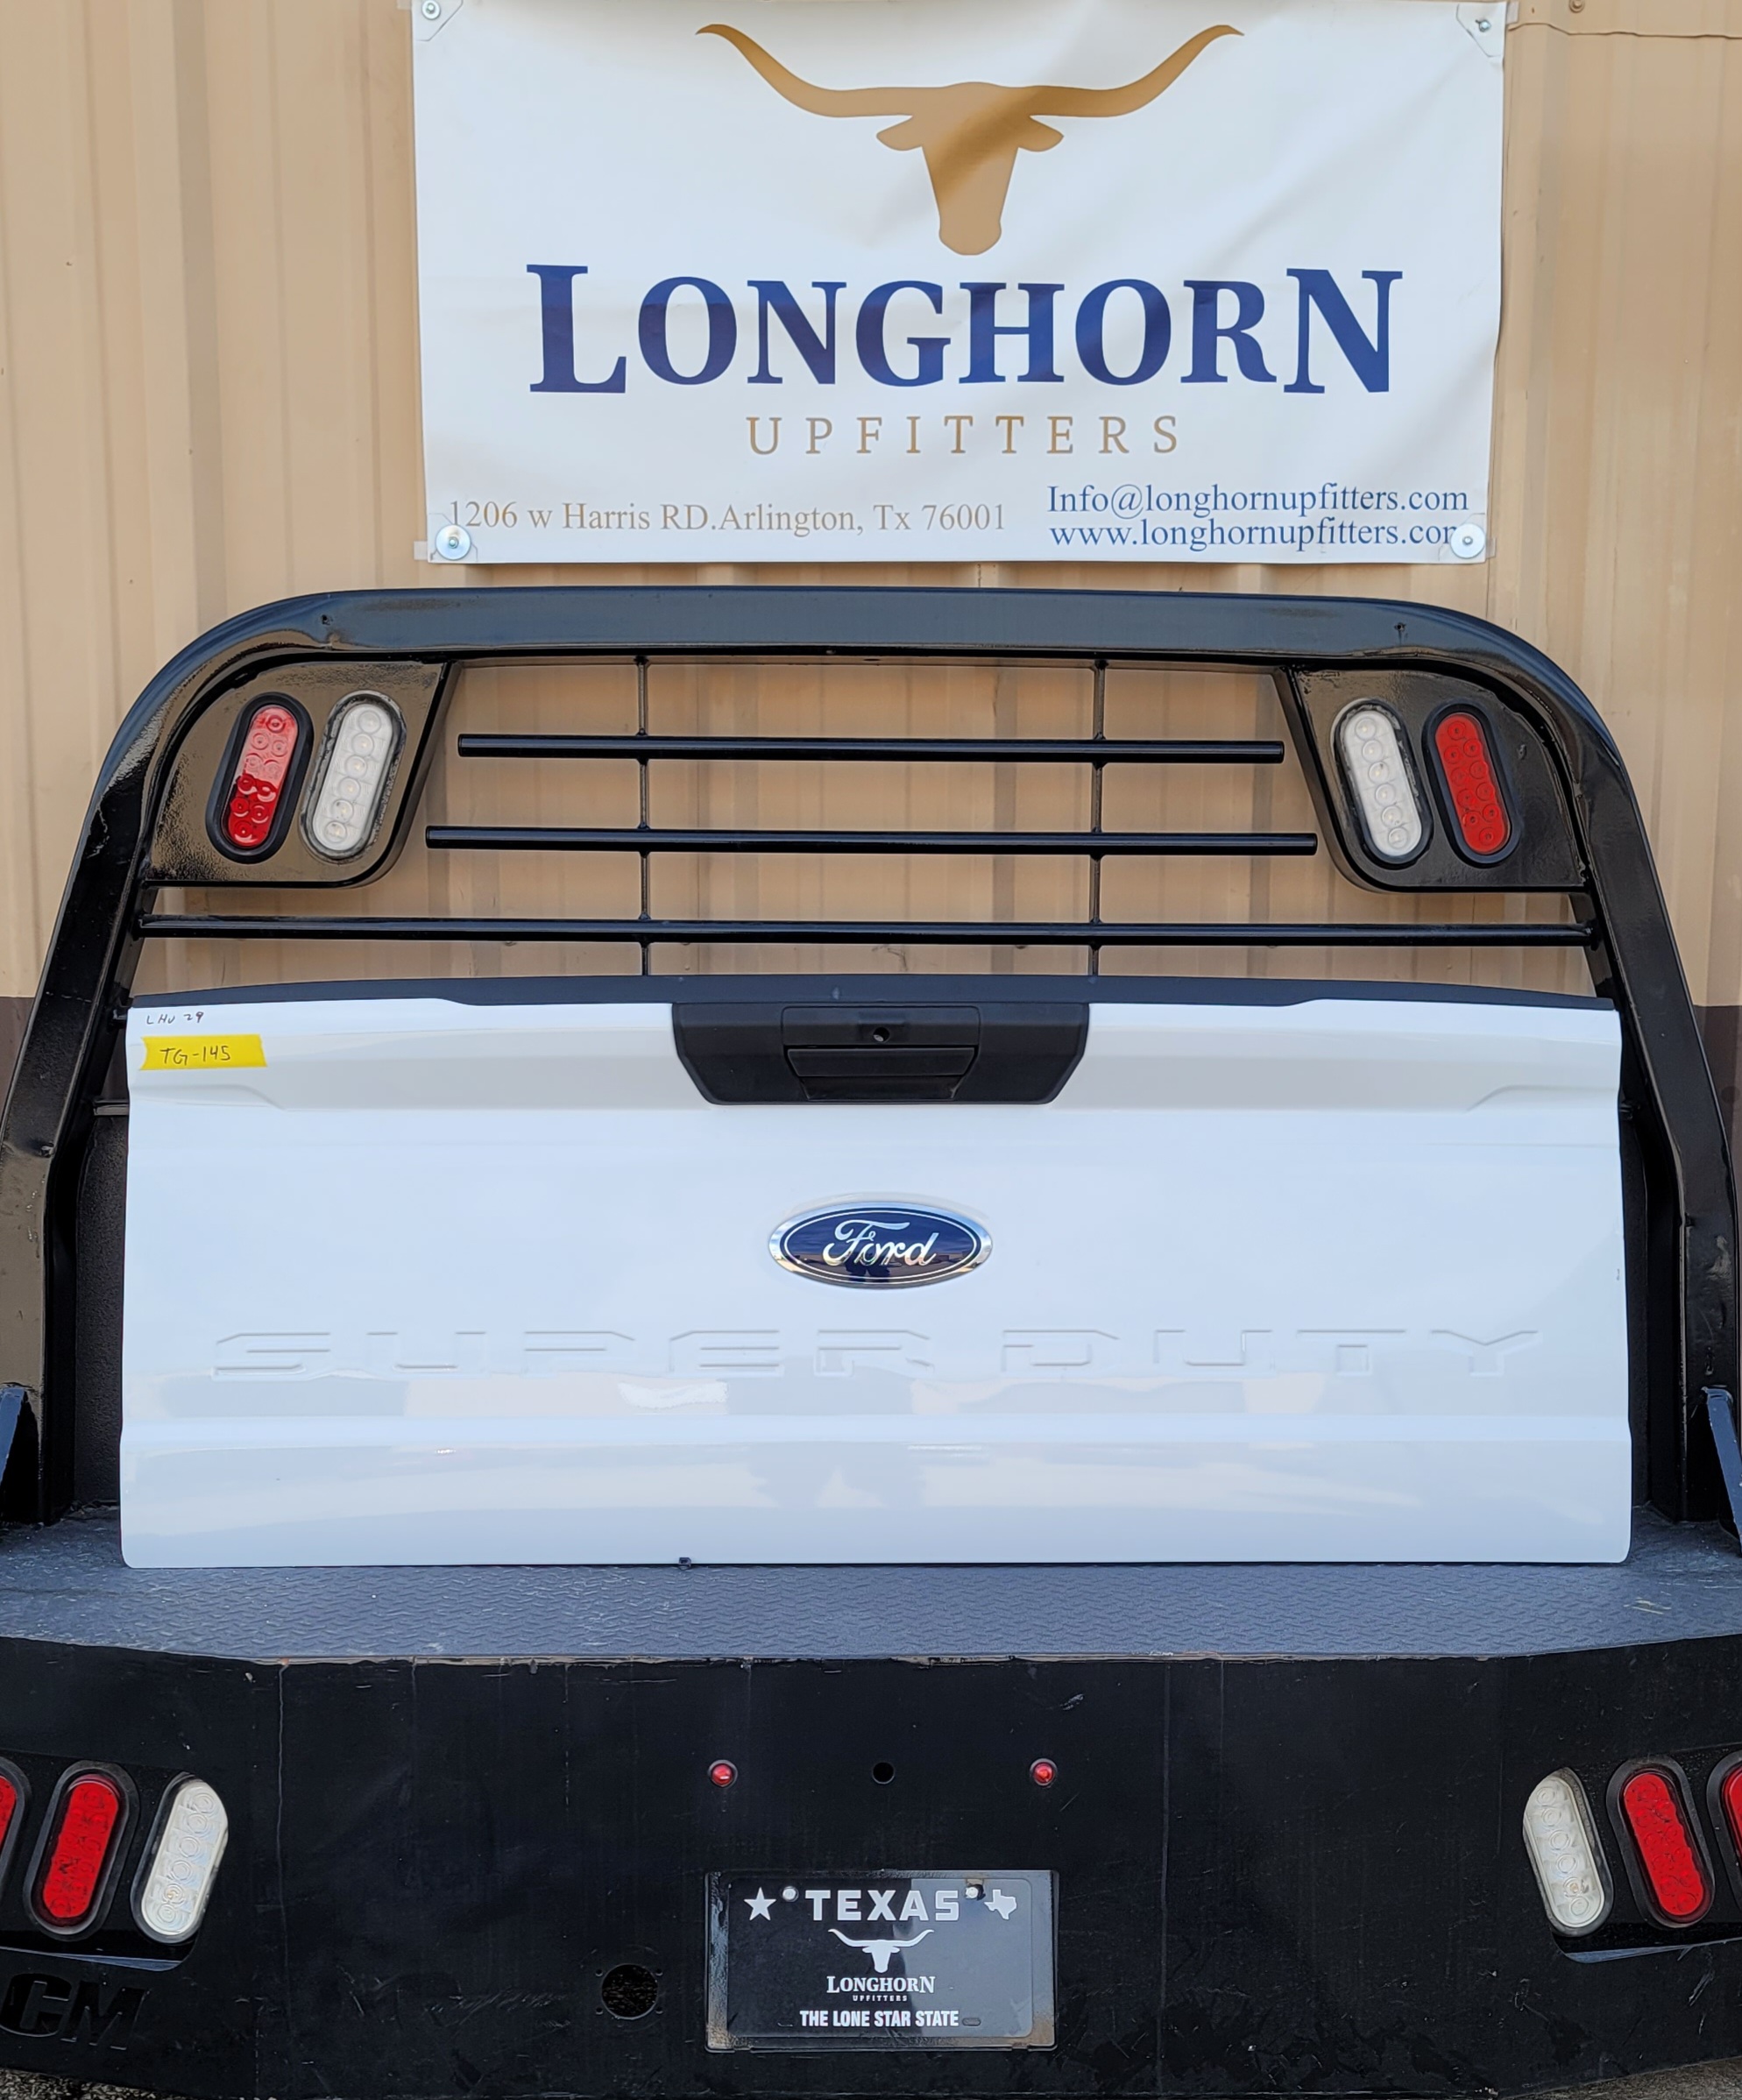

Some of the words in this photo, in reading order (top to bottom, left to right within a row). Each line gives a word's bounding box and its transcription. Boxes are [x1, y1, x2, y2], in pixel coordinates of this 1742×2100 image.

[526, 262, 1403, 395] LONGHORN
[746, 415, 1178, 455] UPFITTERS
[450, 500, 518, 528] 1206
[527, 509, 553, 529] w
[562, 502, 650, 530] Harris
[873, 504, 910, 531] Tx
[921, 503, 1005, 531] 76001
[1047, 483, 1469, 520] Info@longhornupfitters.com
[159, 1045, 231, 1066] TG-145
[823, 1219, 939, 1266] Ford
[210, 1330, 936, 1380] SUPER
[1000, 1329, 1542, 1378] DUTY
[805, 1889, 960, 1921] TEXAS
[826, 1976, 936, 1993] LONGHORN
[0, 1972, 149, 2051] CM
[799, 2011, 829, 2027] THE
[832, 2011, 870, 2027] LONE
[874, 2010, 911, 2027] STAR
[916, 2011, 960, 2027] STATE
